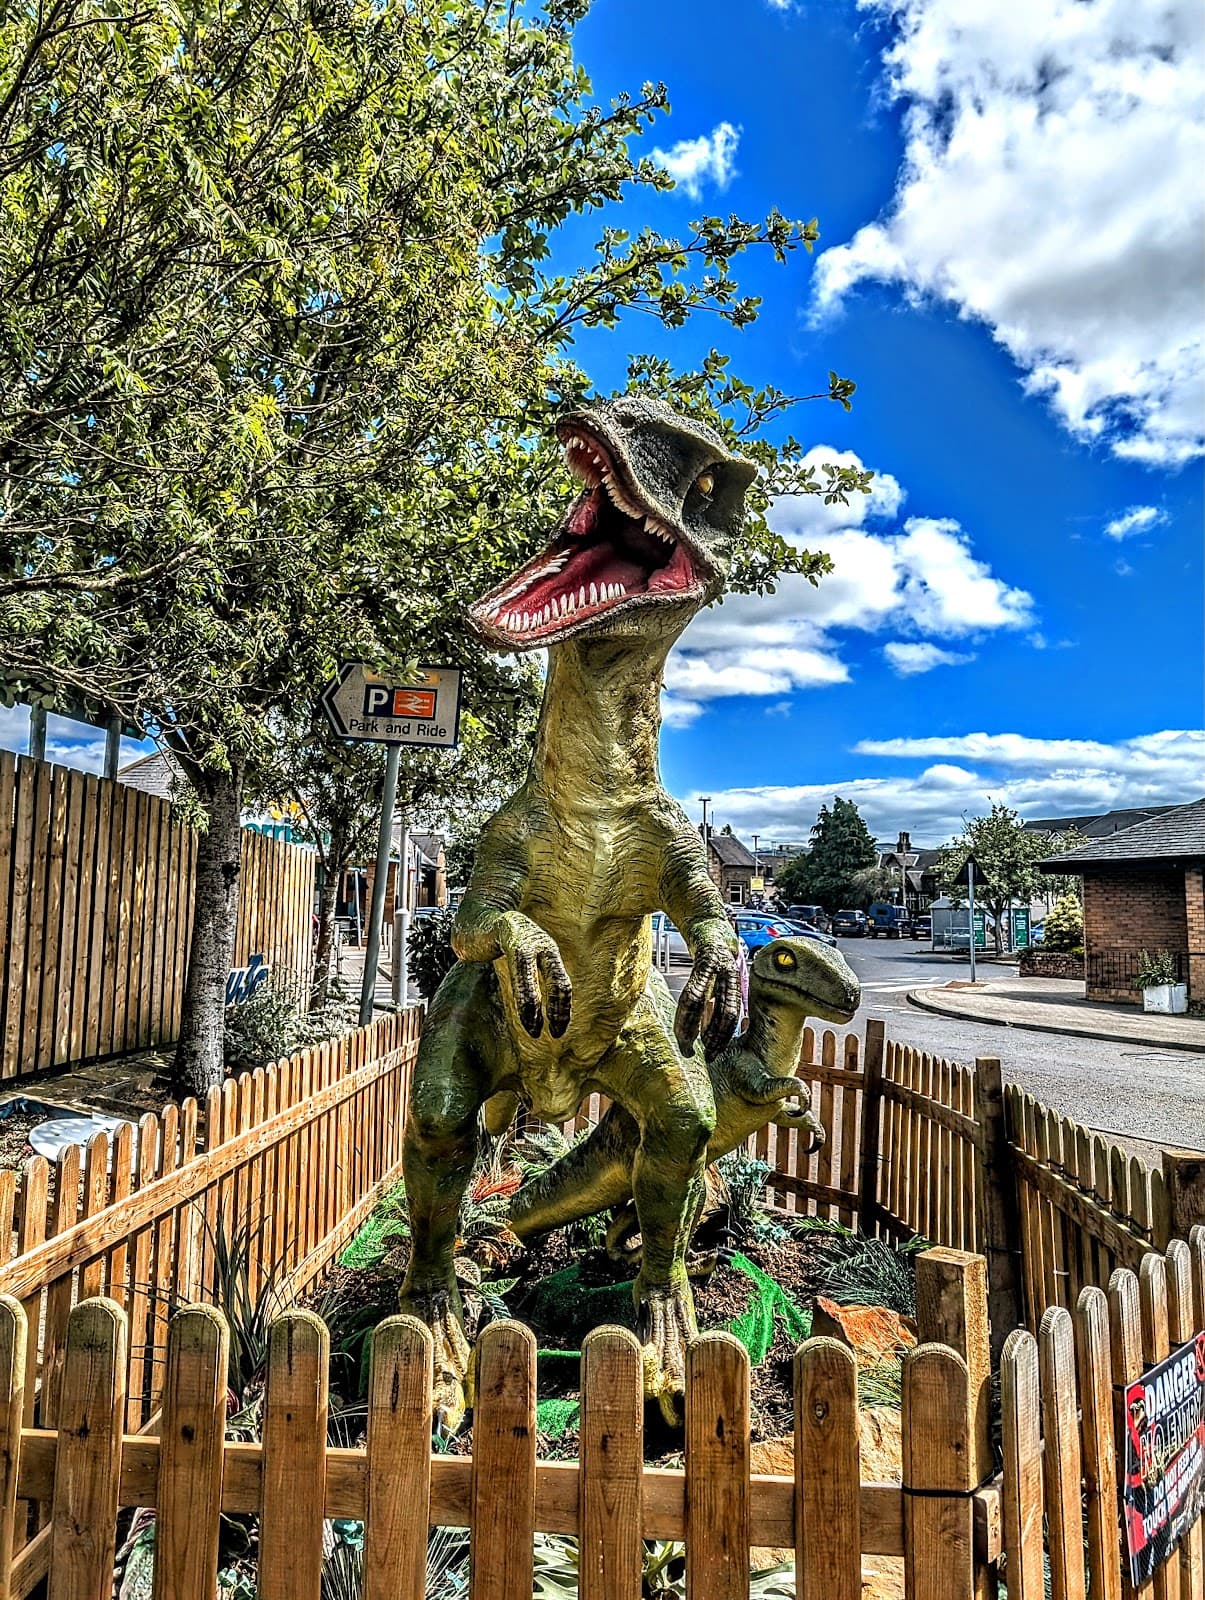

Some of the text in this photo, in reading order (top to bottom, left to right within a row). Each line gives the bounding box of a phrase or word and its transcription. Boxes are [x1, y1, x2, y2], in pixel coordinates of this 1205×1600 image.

[349, 719, 447, 737] Park and Ride
[368, 689, 388, 713] P
[1145, 1352, 1197, 1426] DANGER
[1140, 1386, 1202, 1479] NO ENTRY
[1154, 1480, 1165, 1506] DO
[1165, 1463, 1178, 1493] NOT
[1178, 1448, 1190, 1479] FEED
[1143, 1499, 1167, 1539] TOUCH
[1167, 1485, 1178, 1510] THE
